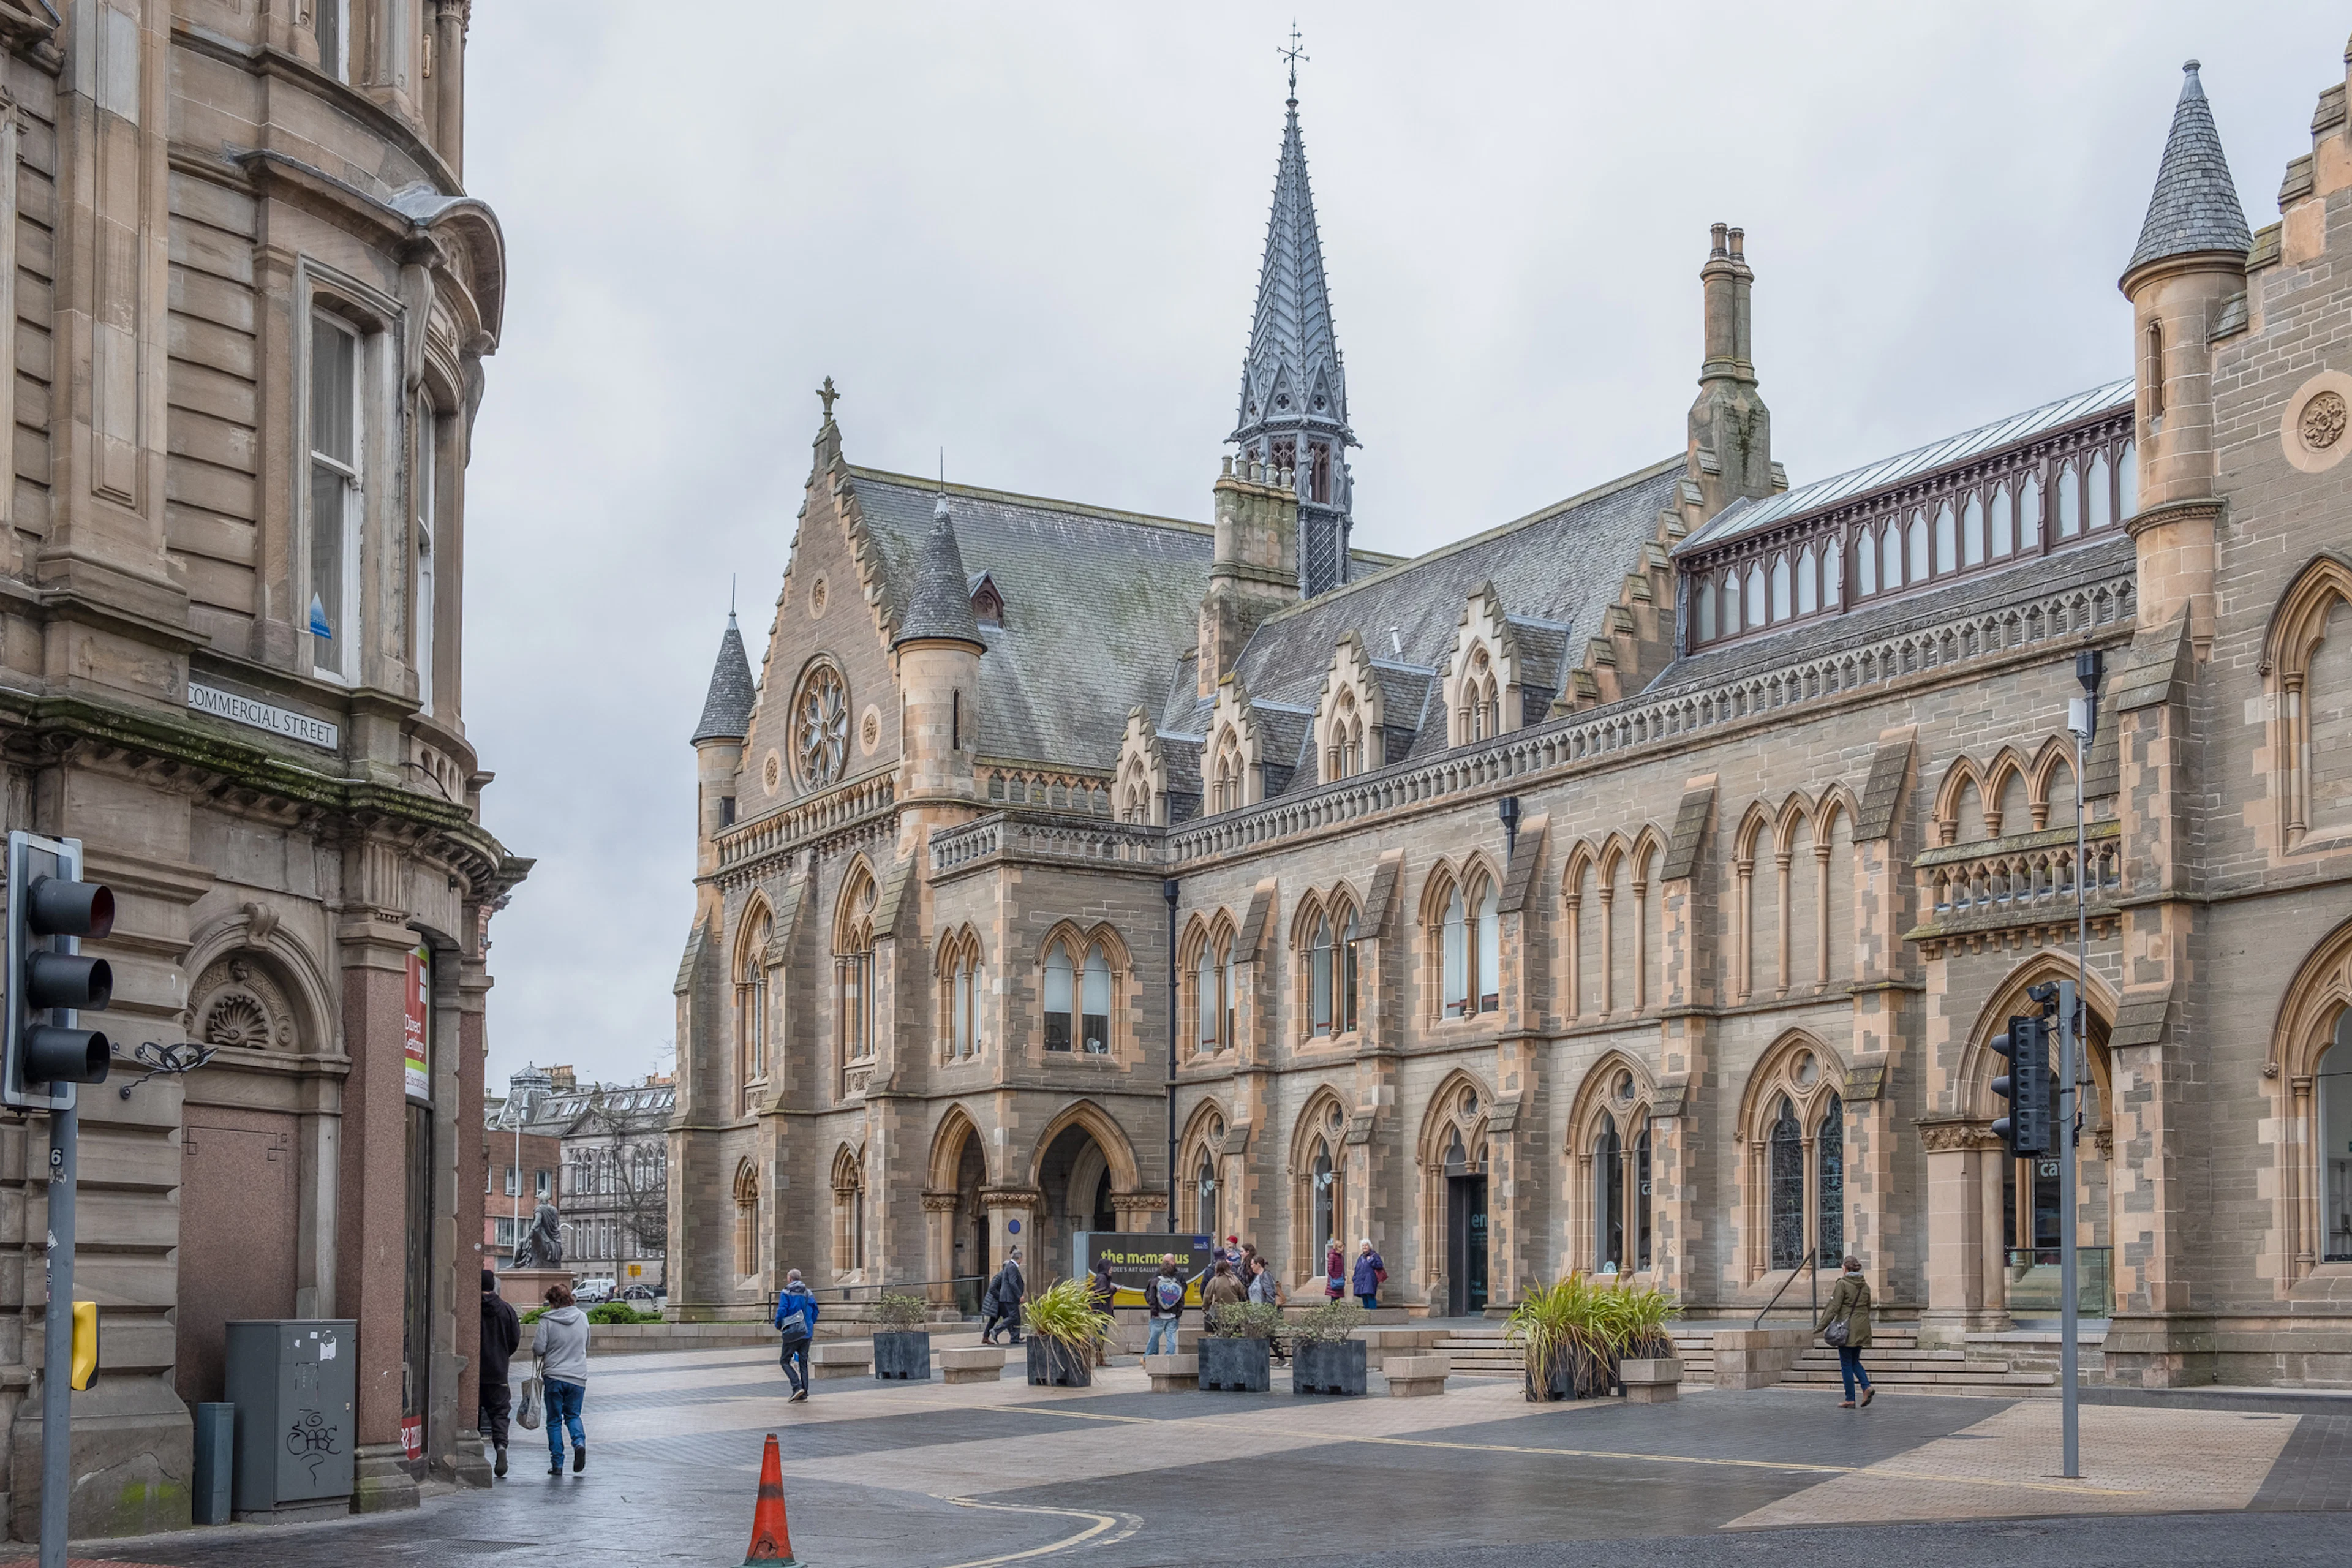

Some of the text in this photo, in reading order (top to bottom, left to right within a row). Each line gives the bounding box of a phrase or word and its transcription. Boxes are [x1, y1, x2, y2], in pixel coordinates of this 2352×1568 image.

[188, 685, 332, 743] COMMERCIAL STREET
[405, 1014, 421, 1035] Direct
[51, 1149, 61, 1165] 6
[1316, 1200, 1333, 1210] sho
[1101, 1249, 1189, 1264] the mcmaus
